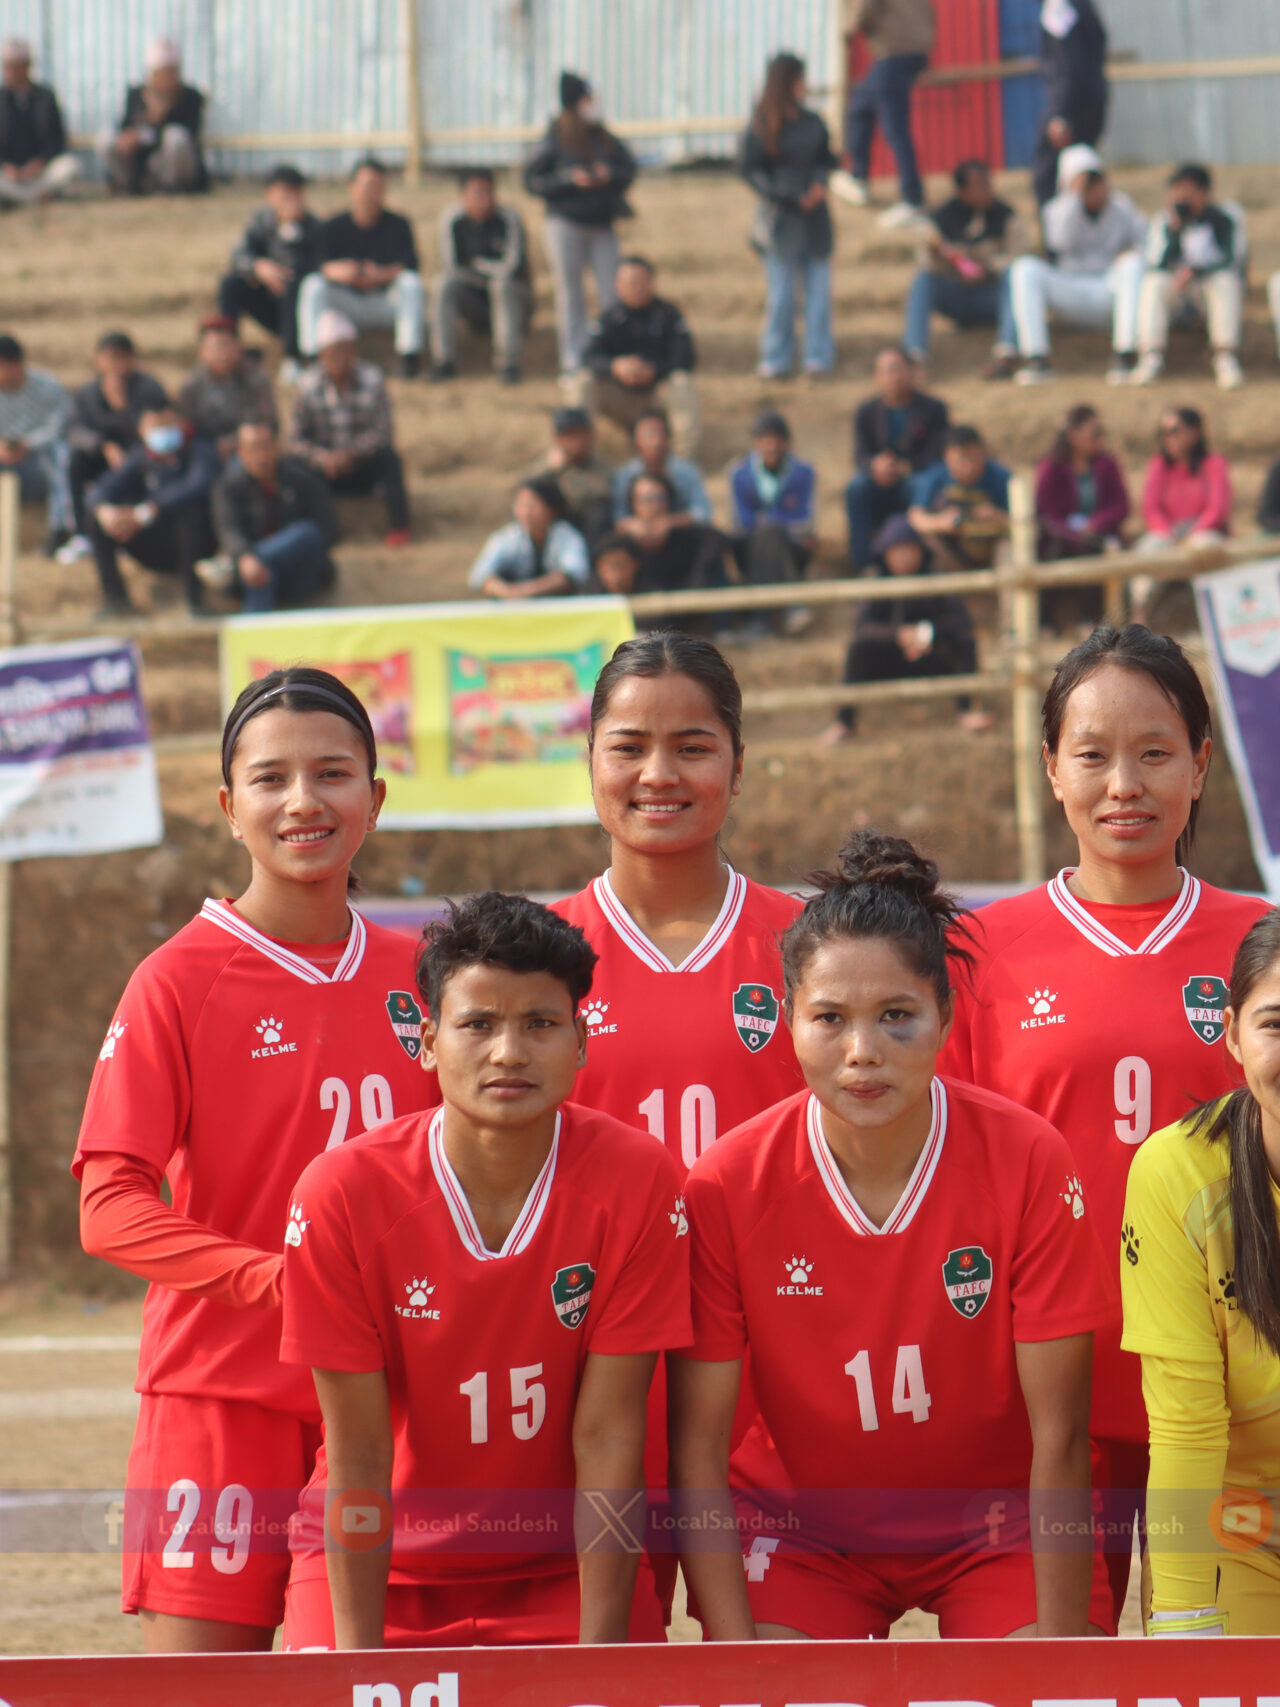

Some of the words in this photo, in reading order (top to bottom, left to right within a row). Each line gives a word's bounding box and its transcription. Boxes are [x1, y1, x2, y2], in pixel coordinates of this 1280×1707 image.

[587, 1024, 618, 1037] LME
[741, 1016, 771, 1032] TAFC
[1021, 1014, 1066, 1030] KELME
[251, 1043, 298, 1059] KELME
[1114, 1056, 1151, 1145] 9
[320, 1074, 395, 1152] 29
[638, 1084, 717, 1170] 10
[777, 1285, 823, 1297] KELME
[953, 1280, 986, 1298] TAFC
[394, 1304, 441, 1321] KELME
[844, 1344, 931, 1432] 14
[459, 1362, 546, 1444] 15
[162, 1478, 254, 1575] 29
